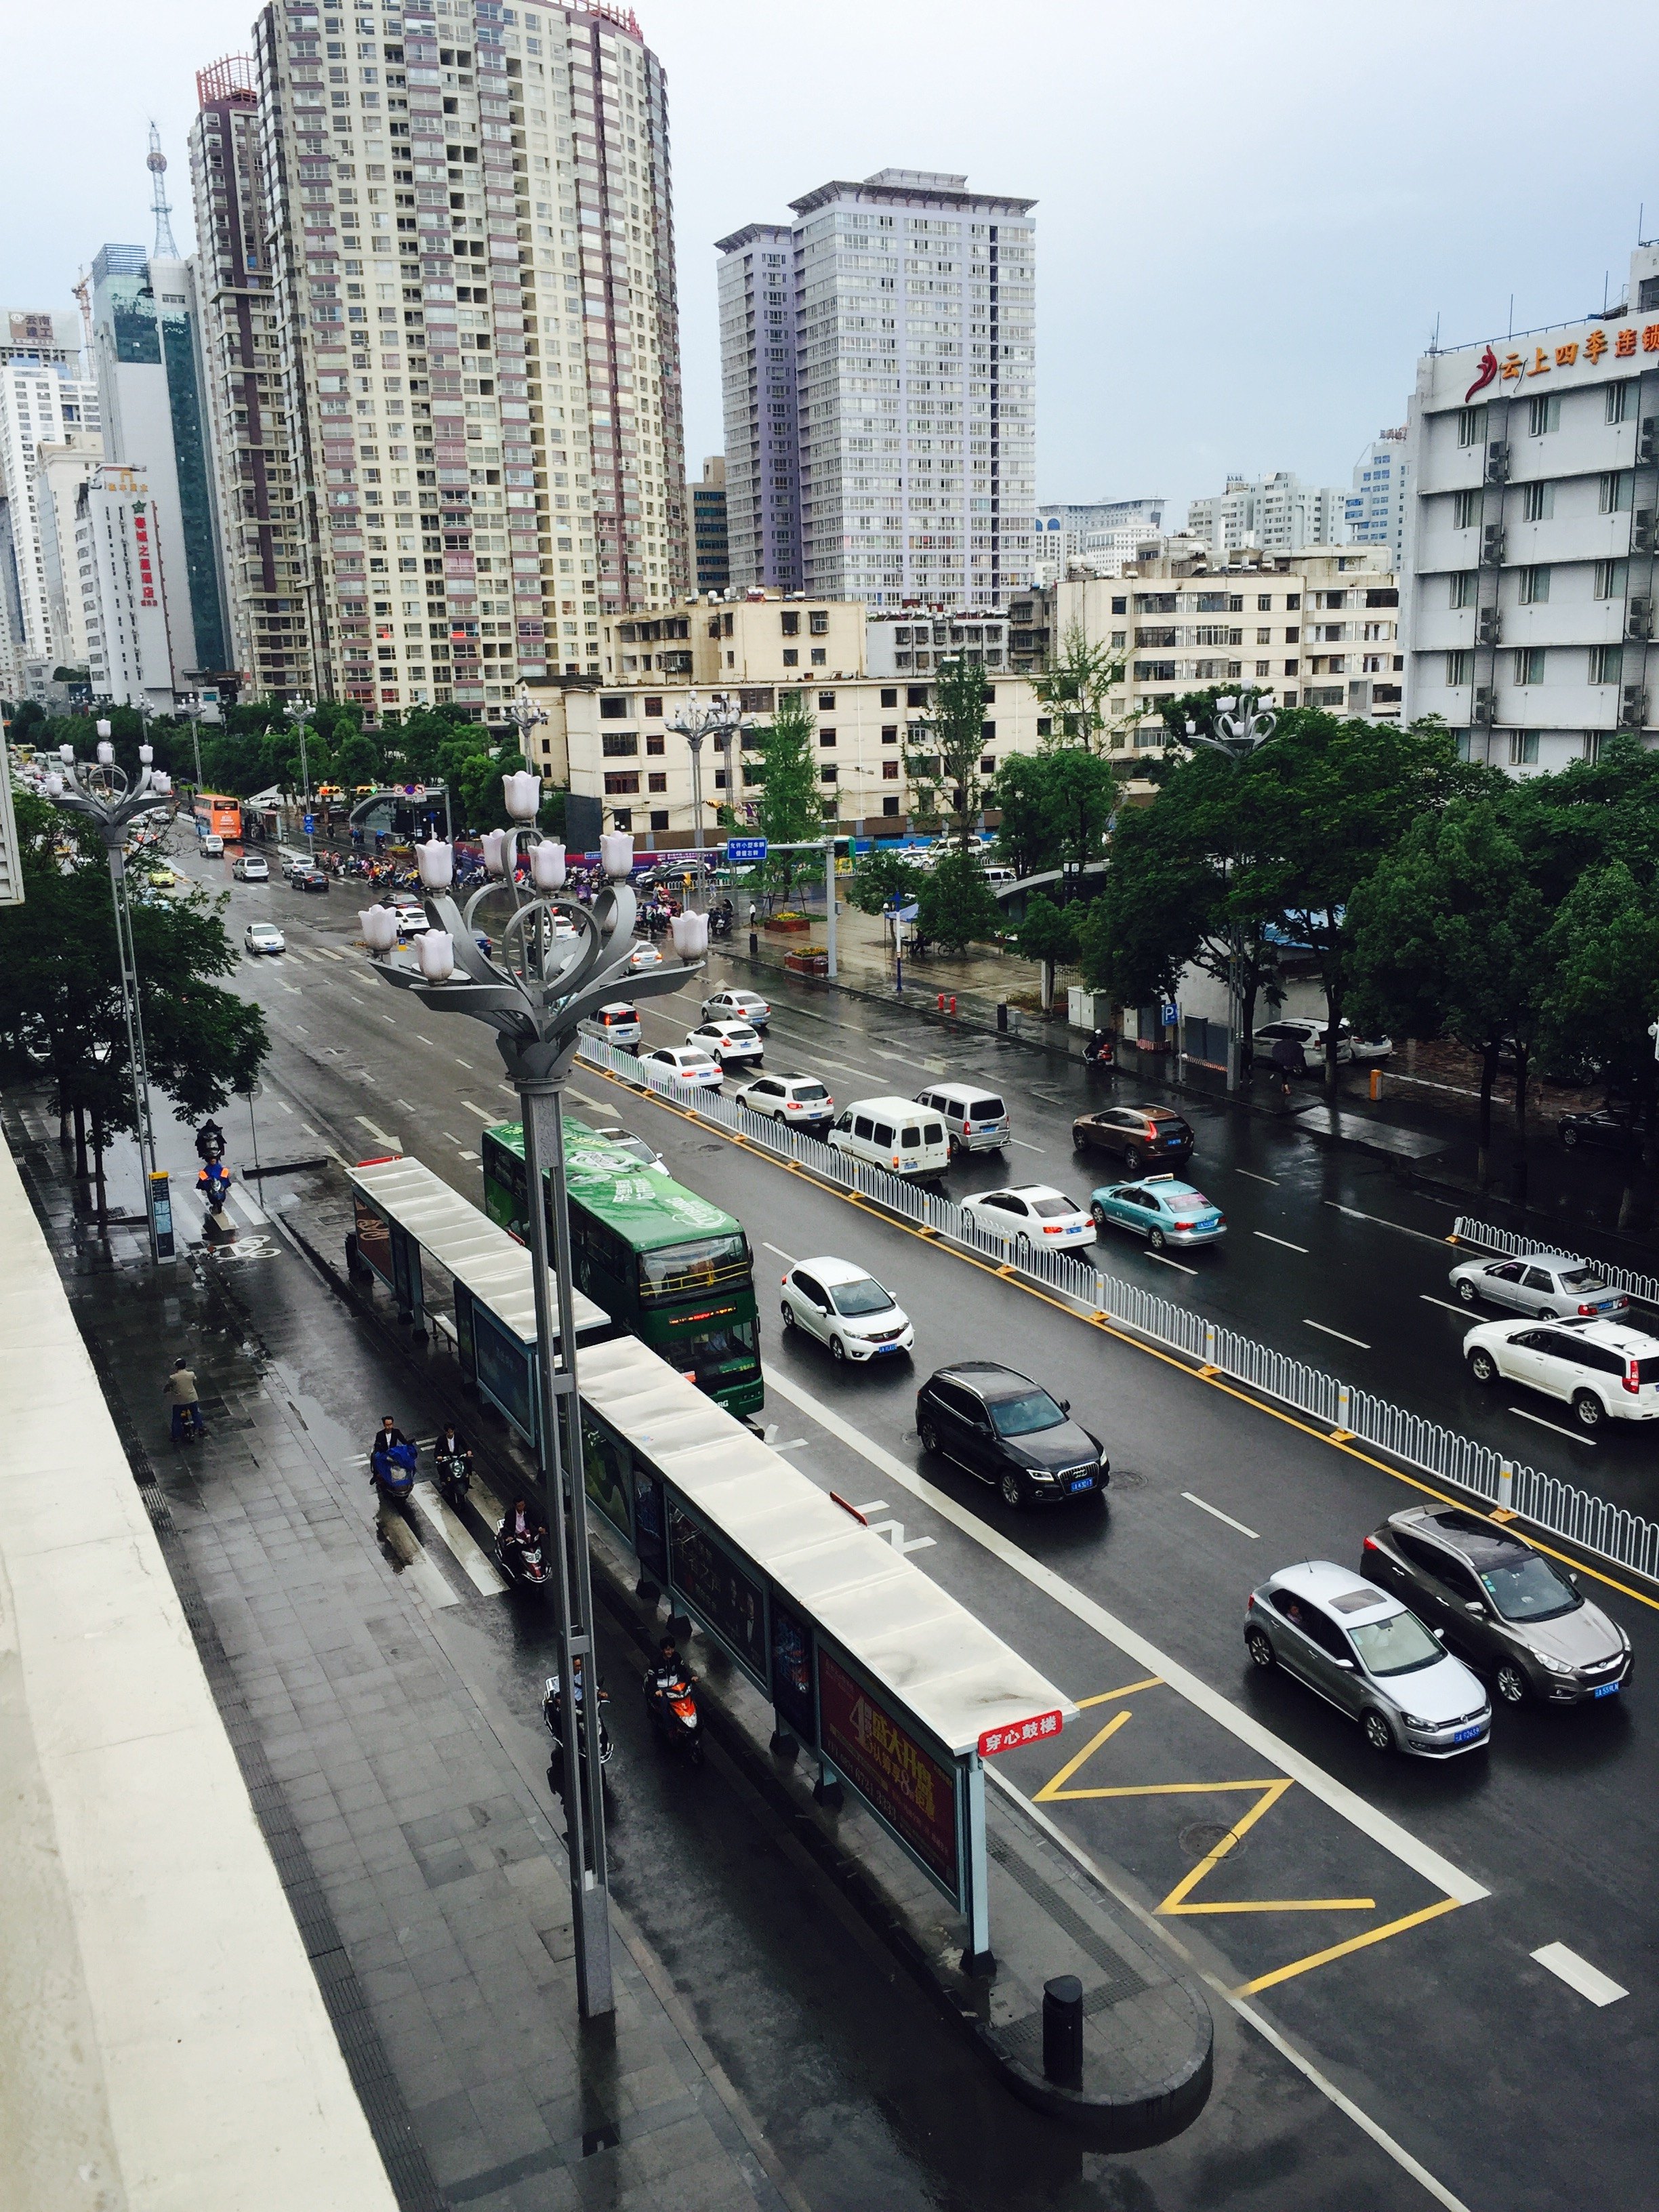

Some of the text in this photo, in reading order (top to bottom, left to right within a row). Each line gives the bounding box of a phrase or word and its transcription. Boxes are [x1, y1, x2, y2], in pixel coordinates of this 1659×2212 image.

[1165, 1006, 1174, 1021] P
[985, 1715, 1057, 1752] 穿心鼓楼
